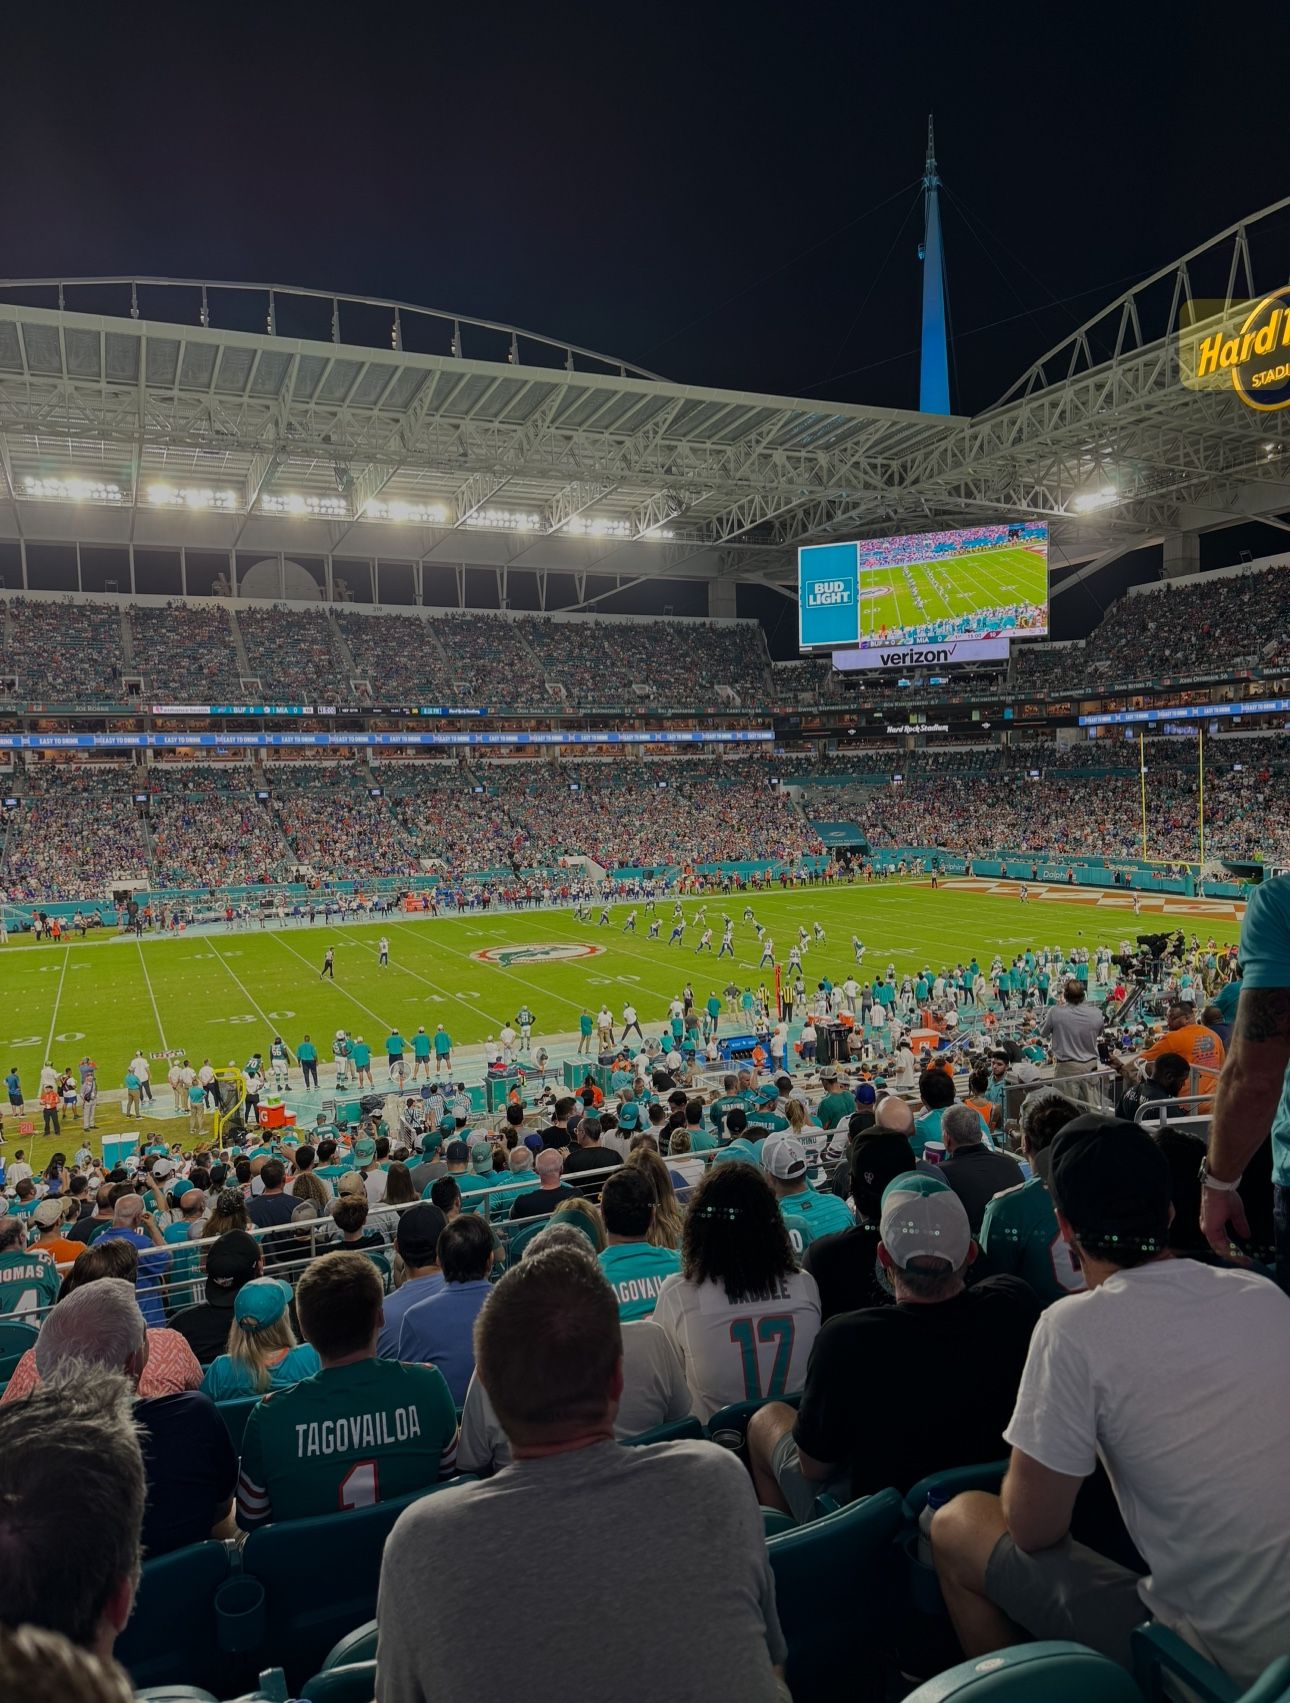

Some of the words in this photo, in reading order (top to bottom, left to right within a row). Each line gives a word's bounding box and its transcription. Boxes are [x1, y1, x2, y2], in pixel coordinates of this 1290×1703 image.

[1198, 308, 1283, 377] Hard
[814, 581, 844, 594] BUD
[809, 590, 850, 605] LIGHT
[870, 640, 882, 648] BUF
[880, 648, 948, 666] verizon
[887, 725, 904, 734] Hard
[904, 724, 920, 734] Rock
[920, 723, 948, 732] Stadium
[1043, 870, 1077, 880] Dolphs
[10, 1032, 86, 1048] 20
[261, 1110, 268, 1122] G
[20, 1122, 33, 1134] 20
[801, 1137, 817, 1146] RINO
[611, 1275, 662, 1304] GOVAI
[730, 1313, 796, 1401] 17
[296, 1405, 421, 1458] TAGOVAILOA
[338, 1459, 381, 1510] 1
